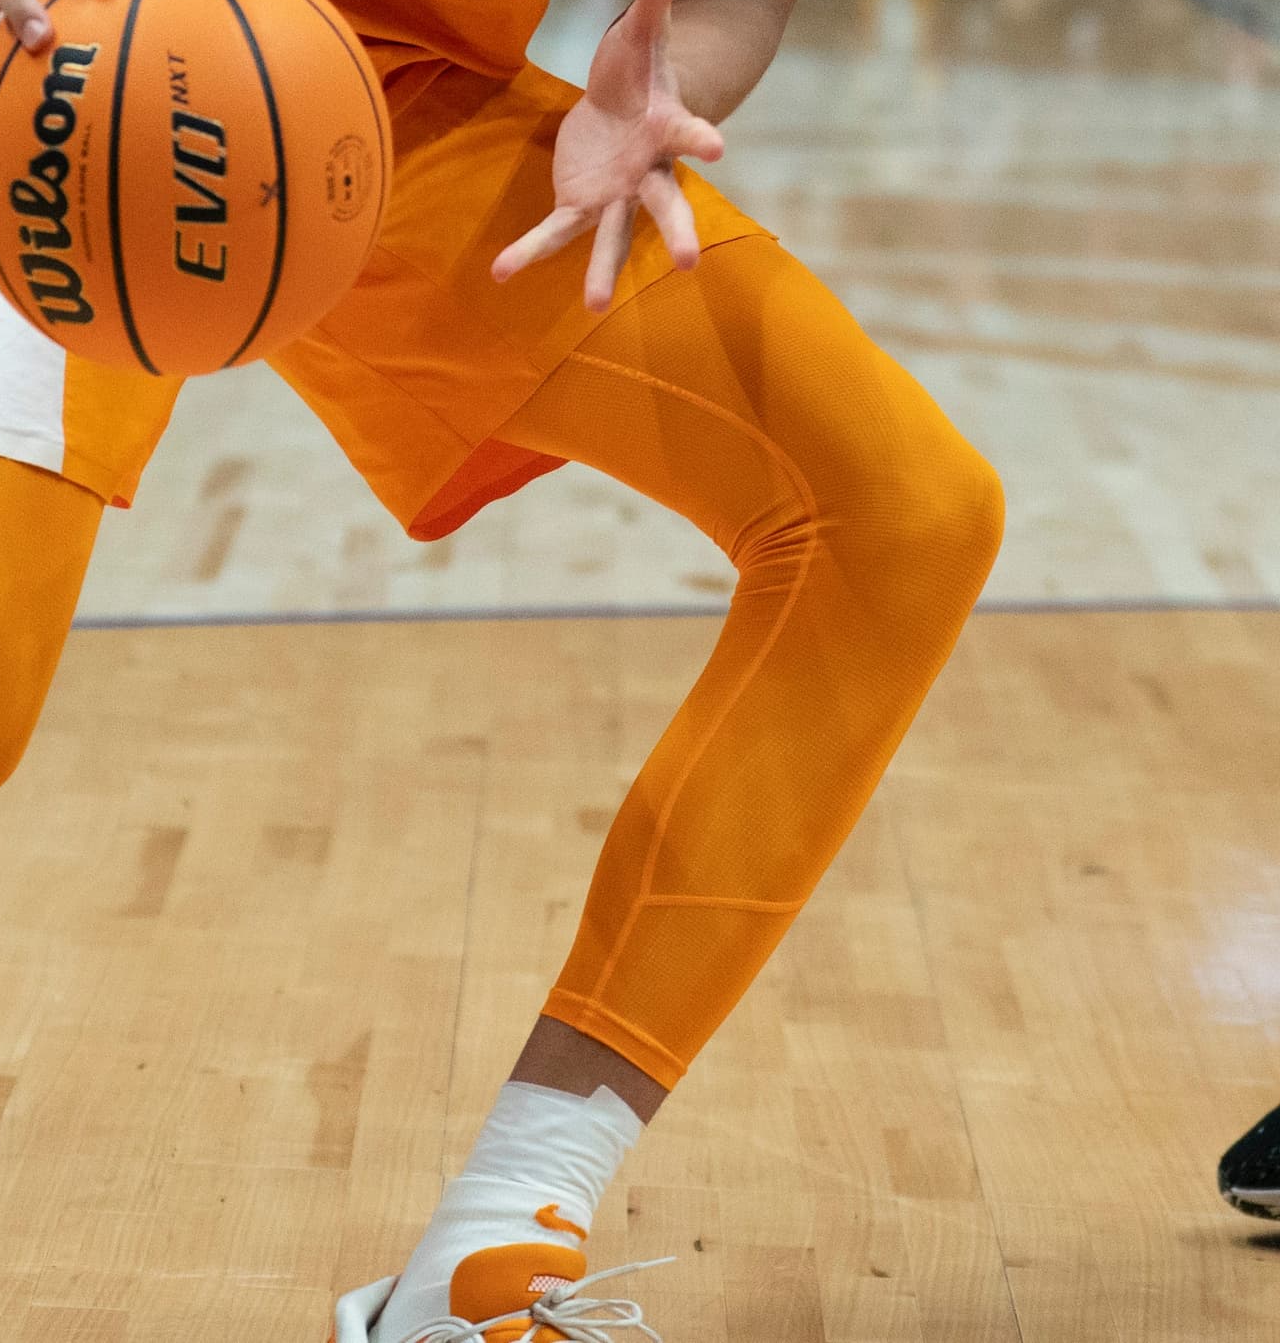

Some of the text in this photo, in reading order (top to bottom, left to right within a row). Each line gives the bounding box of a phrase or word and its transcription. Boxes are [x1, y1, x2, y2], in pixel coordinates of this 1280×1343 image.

[9, 42, 100, 325] Wilson
[168, 50, 228, 283] EVO NXT
